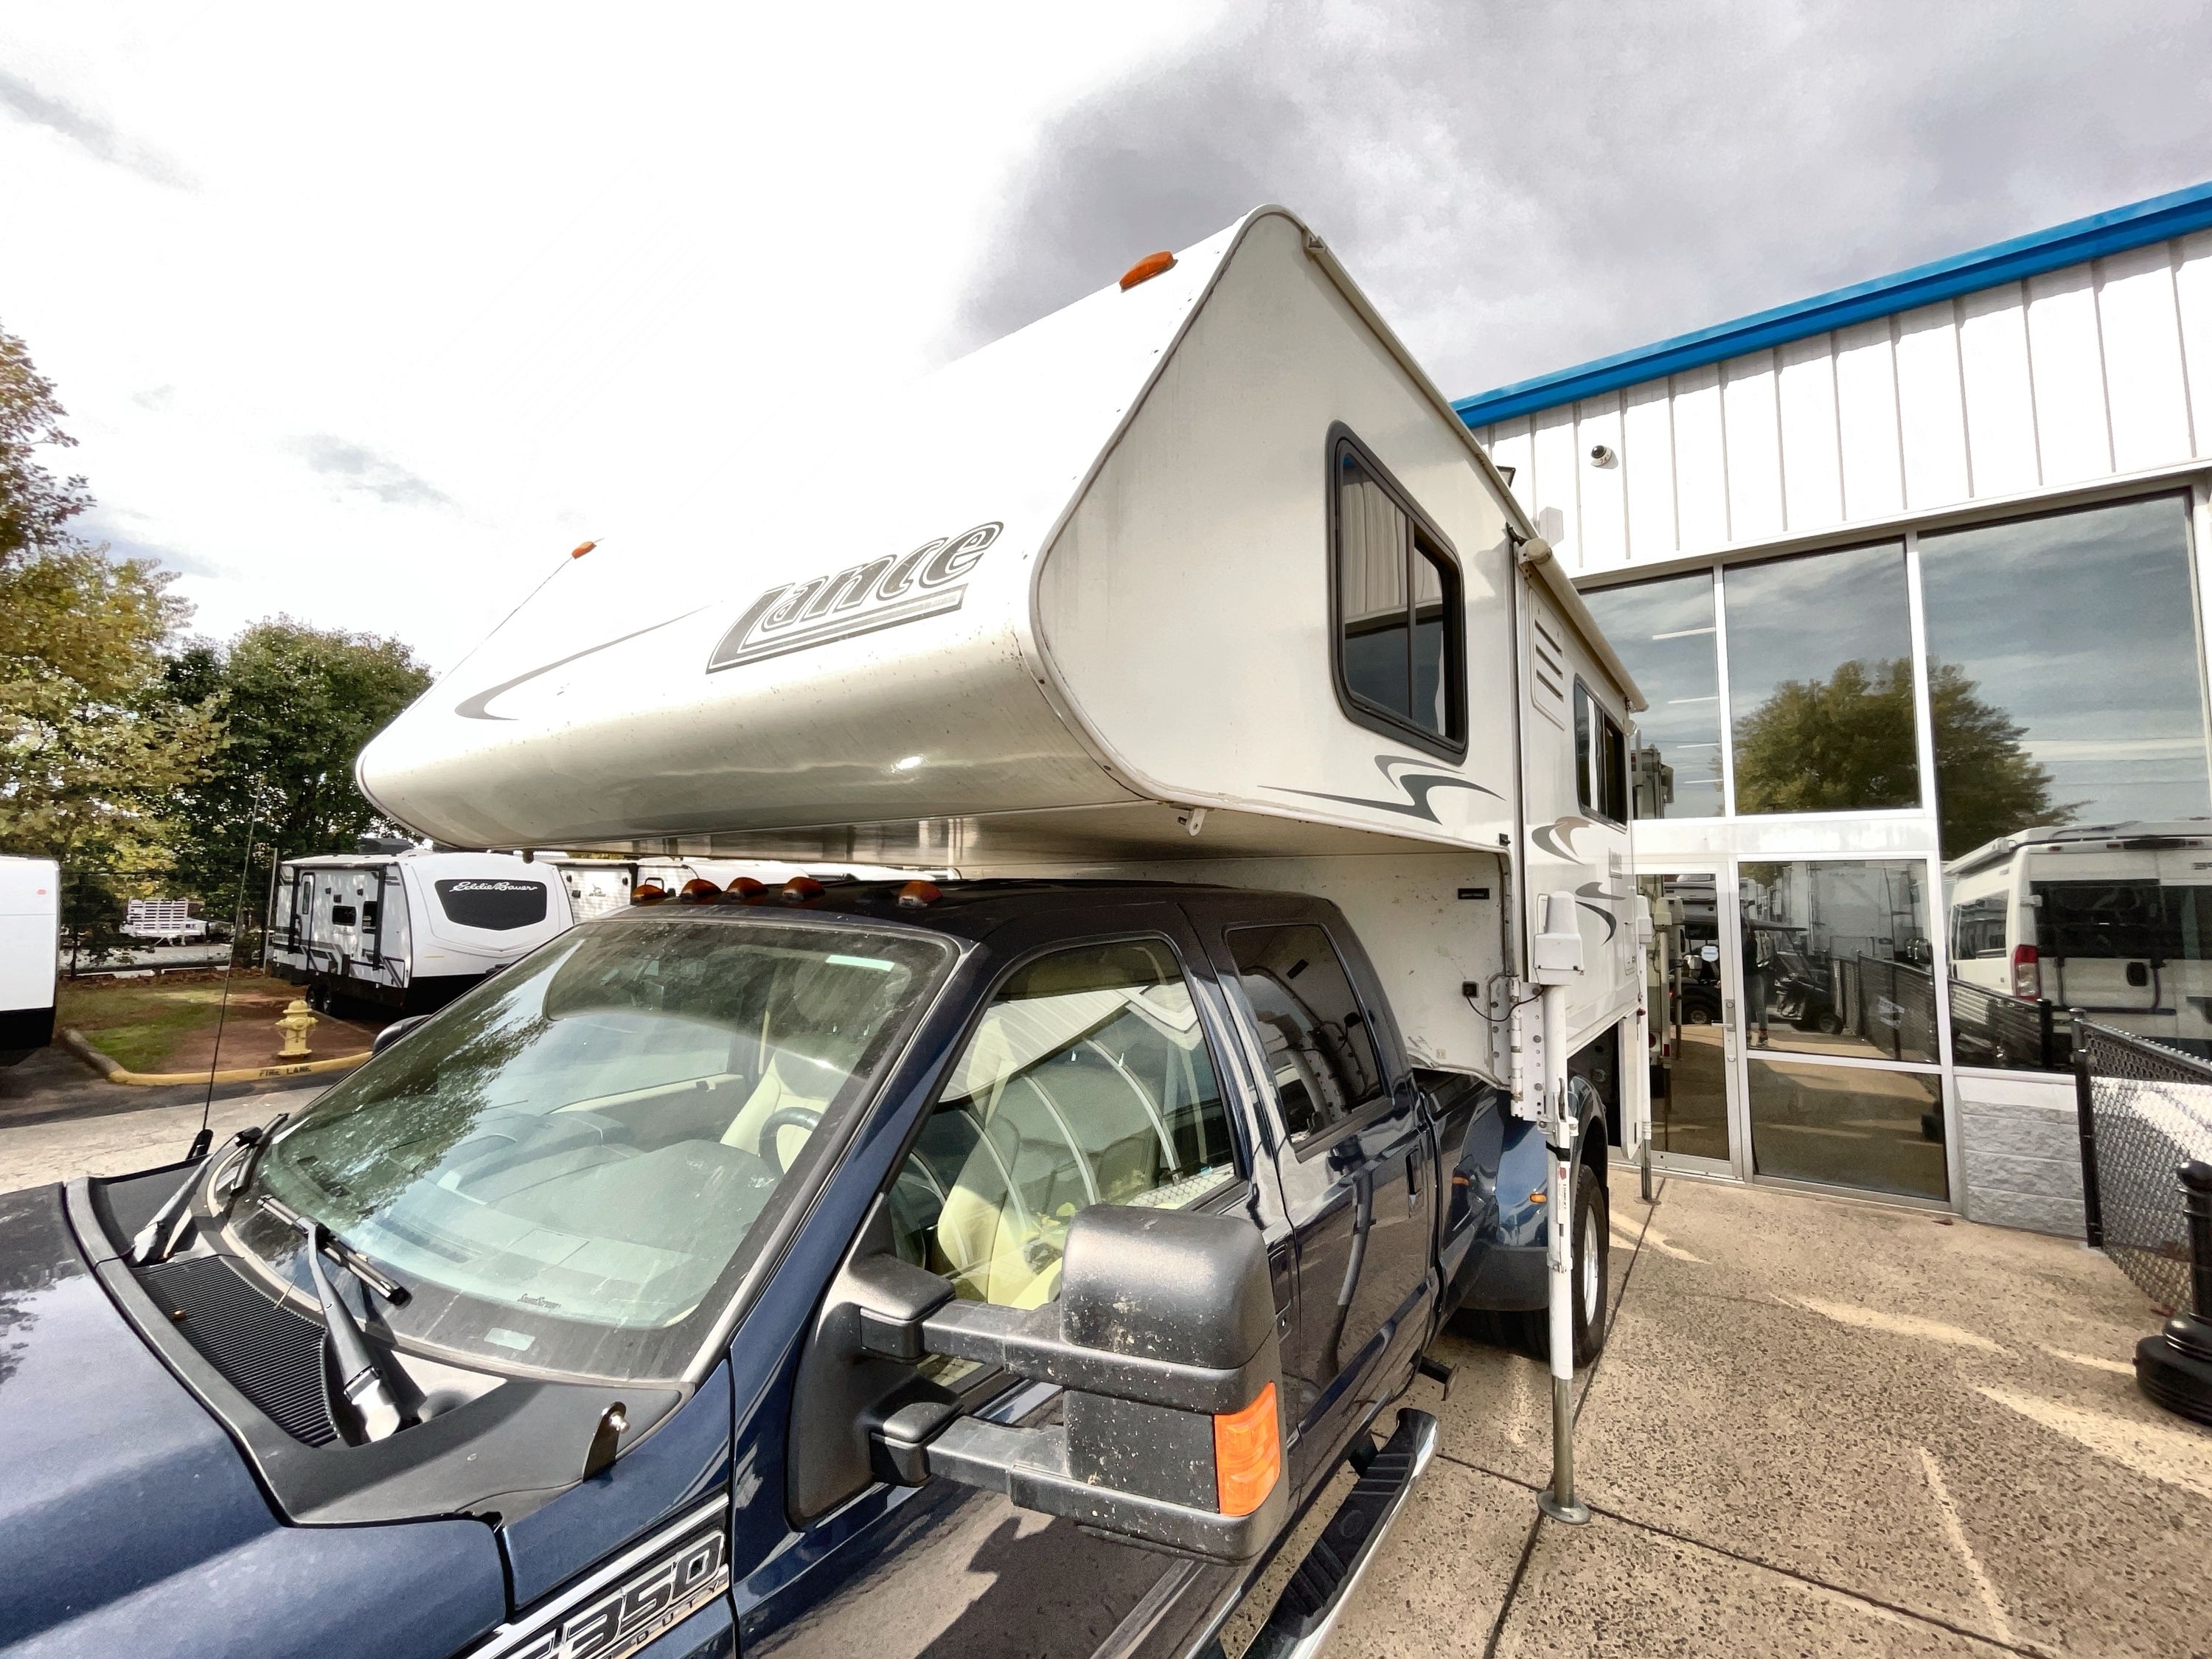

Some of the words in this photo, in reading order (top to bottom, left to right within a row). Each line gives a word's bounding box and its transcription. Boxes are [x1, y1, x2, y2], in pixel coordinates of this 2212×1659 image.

[706, 521, 1004, 675] Lance
[449, 881, 495, 892] Eddie
[493, 881, 538, 891] Bauer
[259, 1068, 281, 1077] FIRE
[286, 1065, 311, 1075] LANE
[636, 1579, 721, 1646] DUTY
